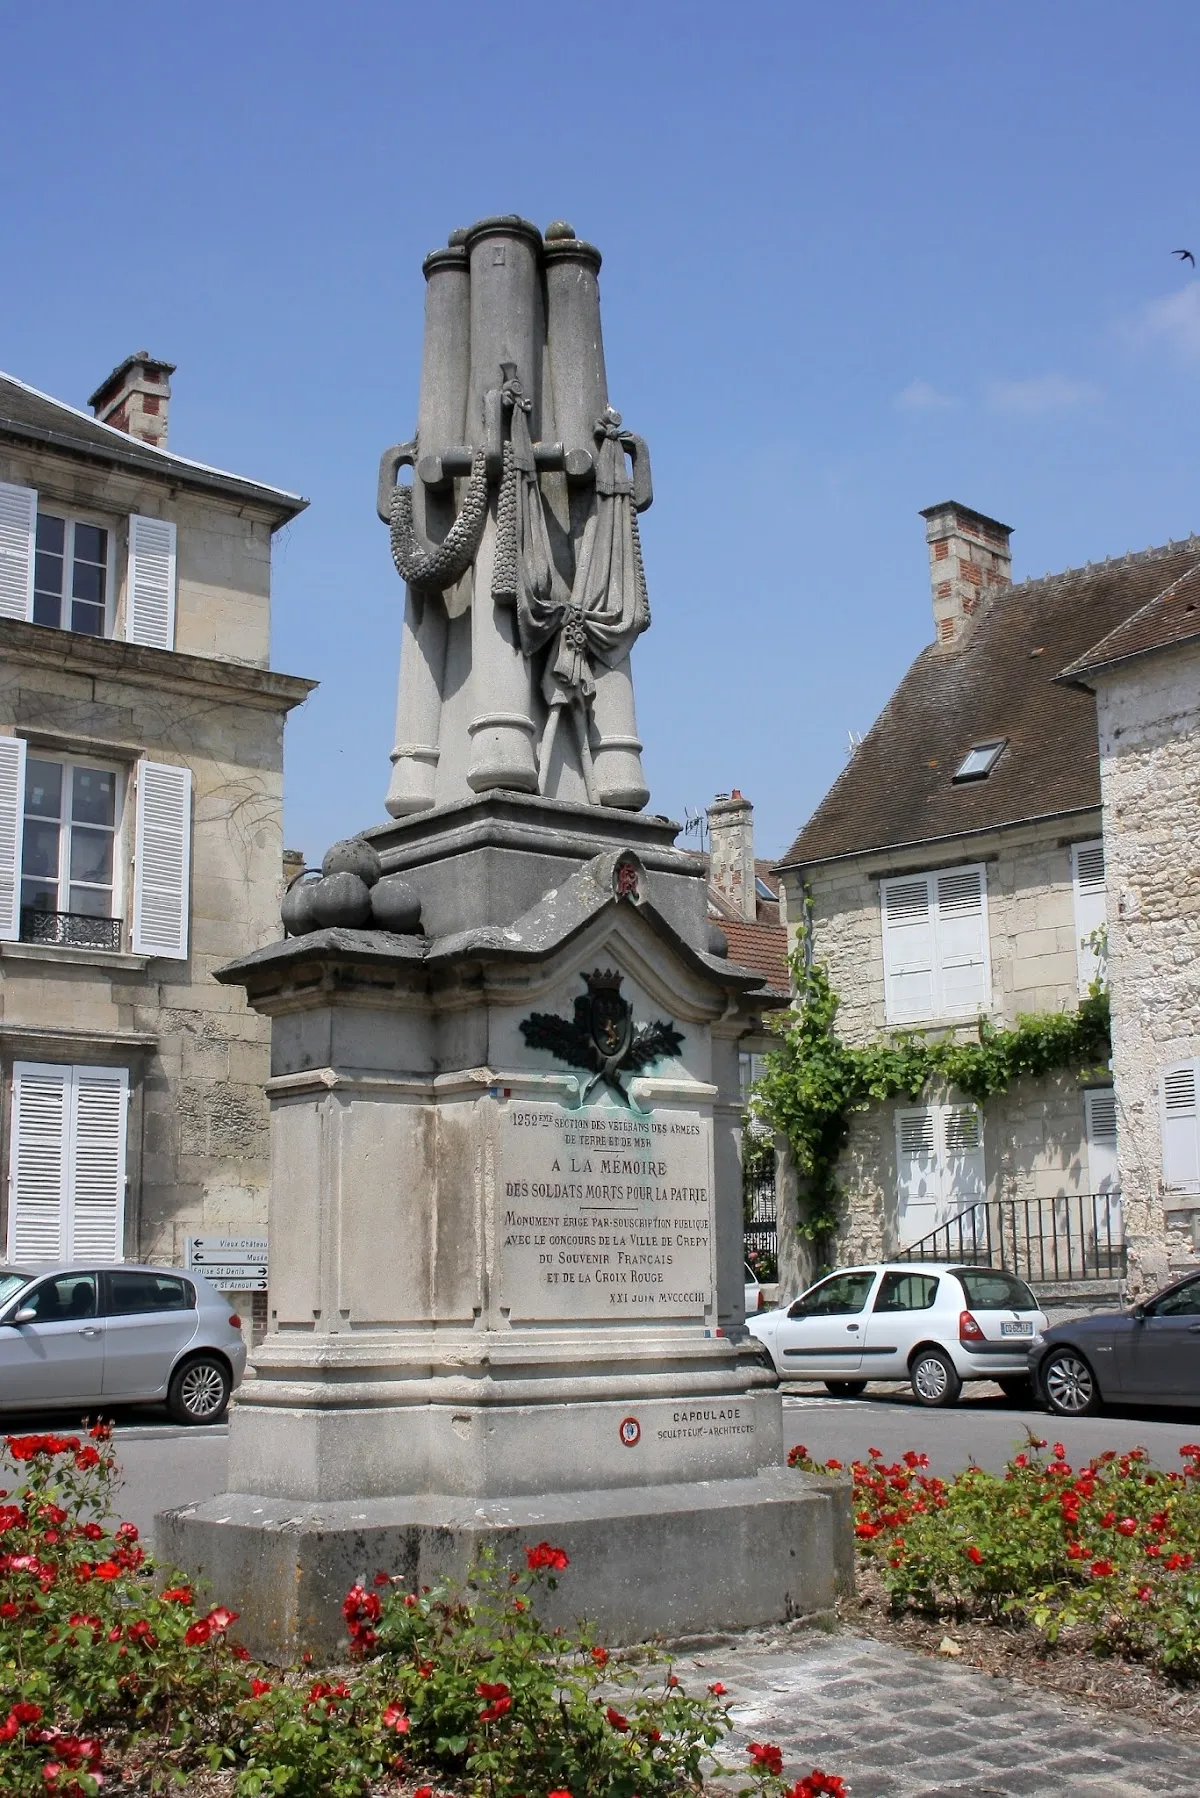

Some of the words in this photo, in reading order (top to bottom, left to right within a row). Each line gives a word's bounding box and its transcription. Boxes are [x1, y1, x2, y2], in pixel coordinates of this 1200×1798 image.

[591, 1120, 606, 1130] DES
[651, 1123, 667, 1134] DES
[565, 1135, 576, 1145] DE
[580, 1136, 607, 1146] TERRE
[608, 1137, 620, 1147] ET
[621, 1137, 632, 1147] DE
[634, 1138, 652, 1148] MER
[552, 1160, 561, 1172] A
[571, 1158, 593, 1173] LA
[600, 1157, 667, 1177] MÉMOIRE
[506, 1182, 529, 1198] DES
[531, 1183, 583, 1199] SOLDATS
[586, 1184, 624, 1201] MORTS
[627, 1186, 655, 1202] POUR
[656, 1188, 670, 1201] LA
[670, 1188, 708, 1203] PATRIE
[674, 1219, 709, 1231] PUBLIQUE
[240, 1240, 268, 1248] Château
[504, 1235, 531, 1247] AVEC
[534, 1235, 546, 1245] LE
[549, 1236, 597, 1246] CONCOURS
[599, 1236, 610, 1246] DE
[613, 1236, 626, 1246] LA
[629, 1234, 658, 1247] VILLE
[661, 1237, 672, 1247] DE
[539, 1254, 553, 1264] DU
[558, 1252, 610, 1265] SOUVENIR
[216, 1267, 224, 1275] St
[226, 1267, 245, 1275] Denis
[546, 1273, 559, 1283] ET
[563, 1273, 576, 1283] DE
[578, 1273, 591, 1283] LA
[595, 1270, 627, 1283] CROIX
[630, 1271, 664, 1283] ROUGE
[220, 1281, 228, 1289] St
[609, 1292, 628, 1304] XXI
[631, 1294, 655, 1304] JUIN
[673, 1408, 741, 1422] CAPOULADE
